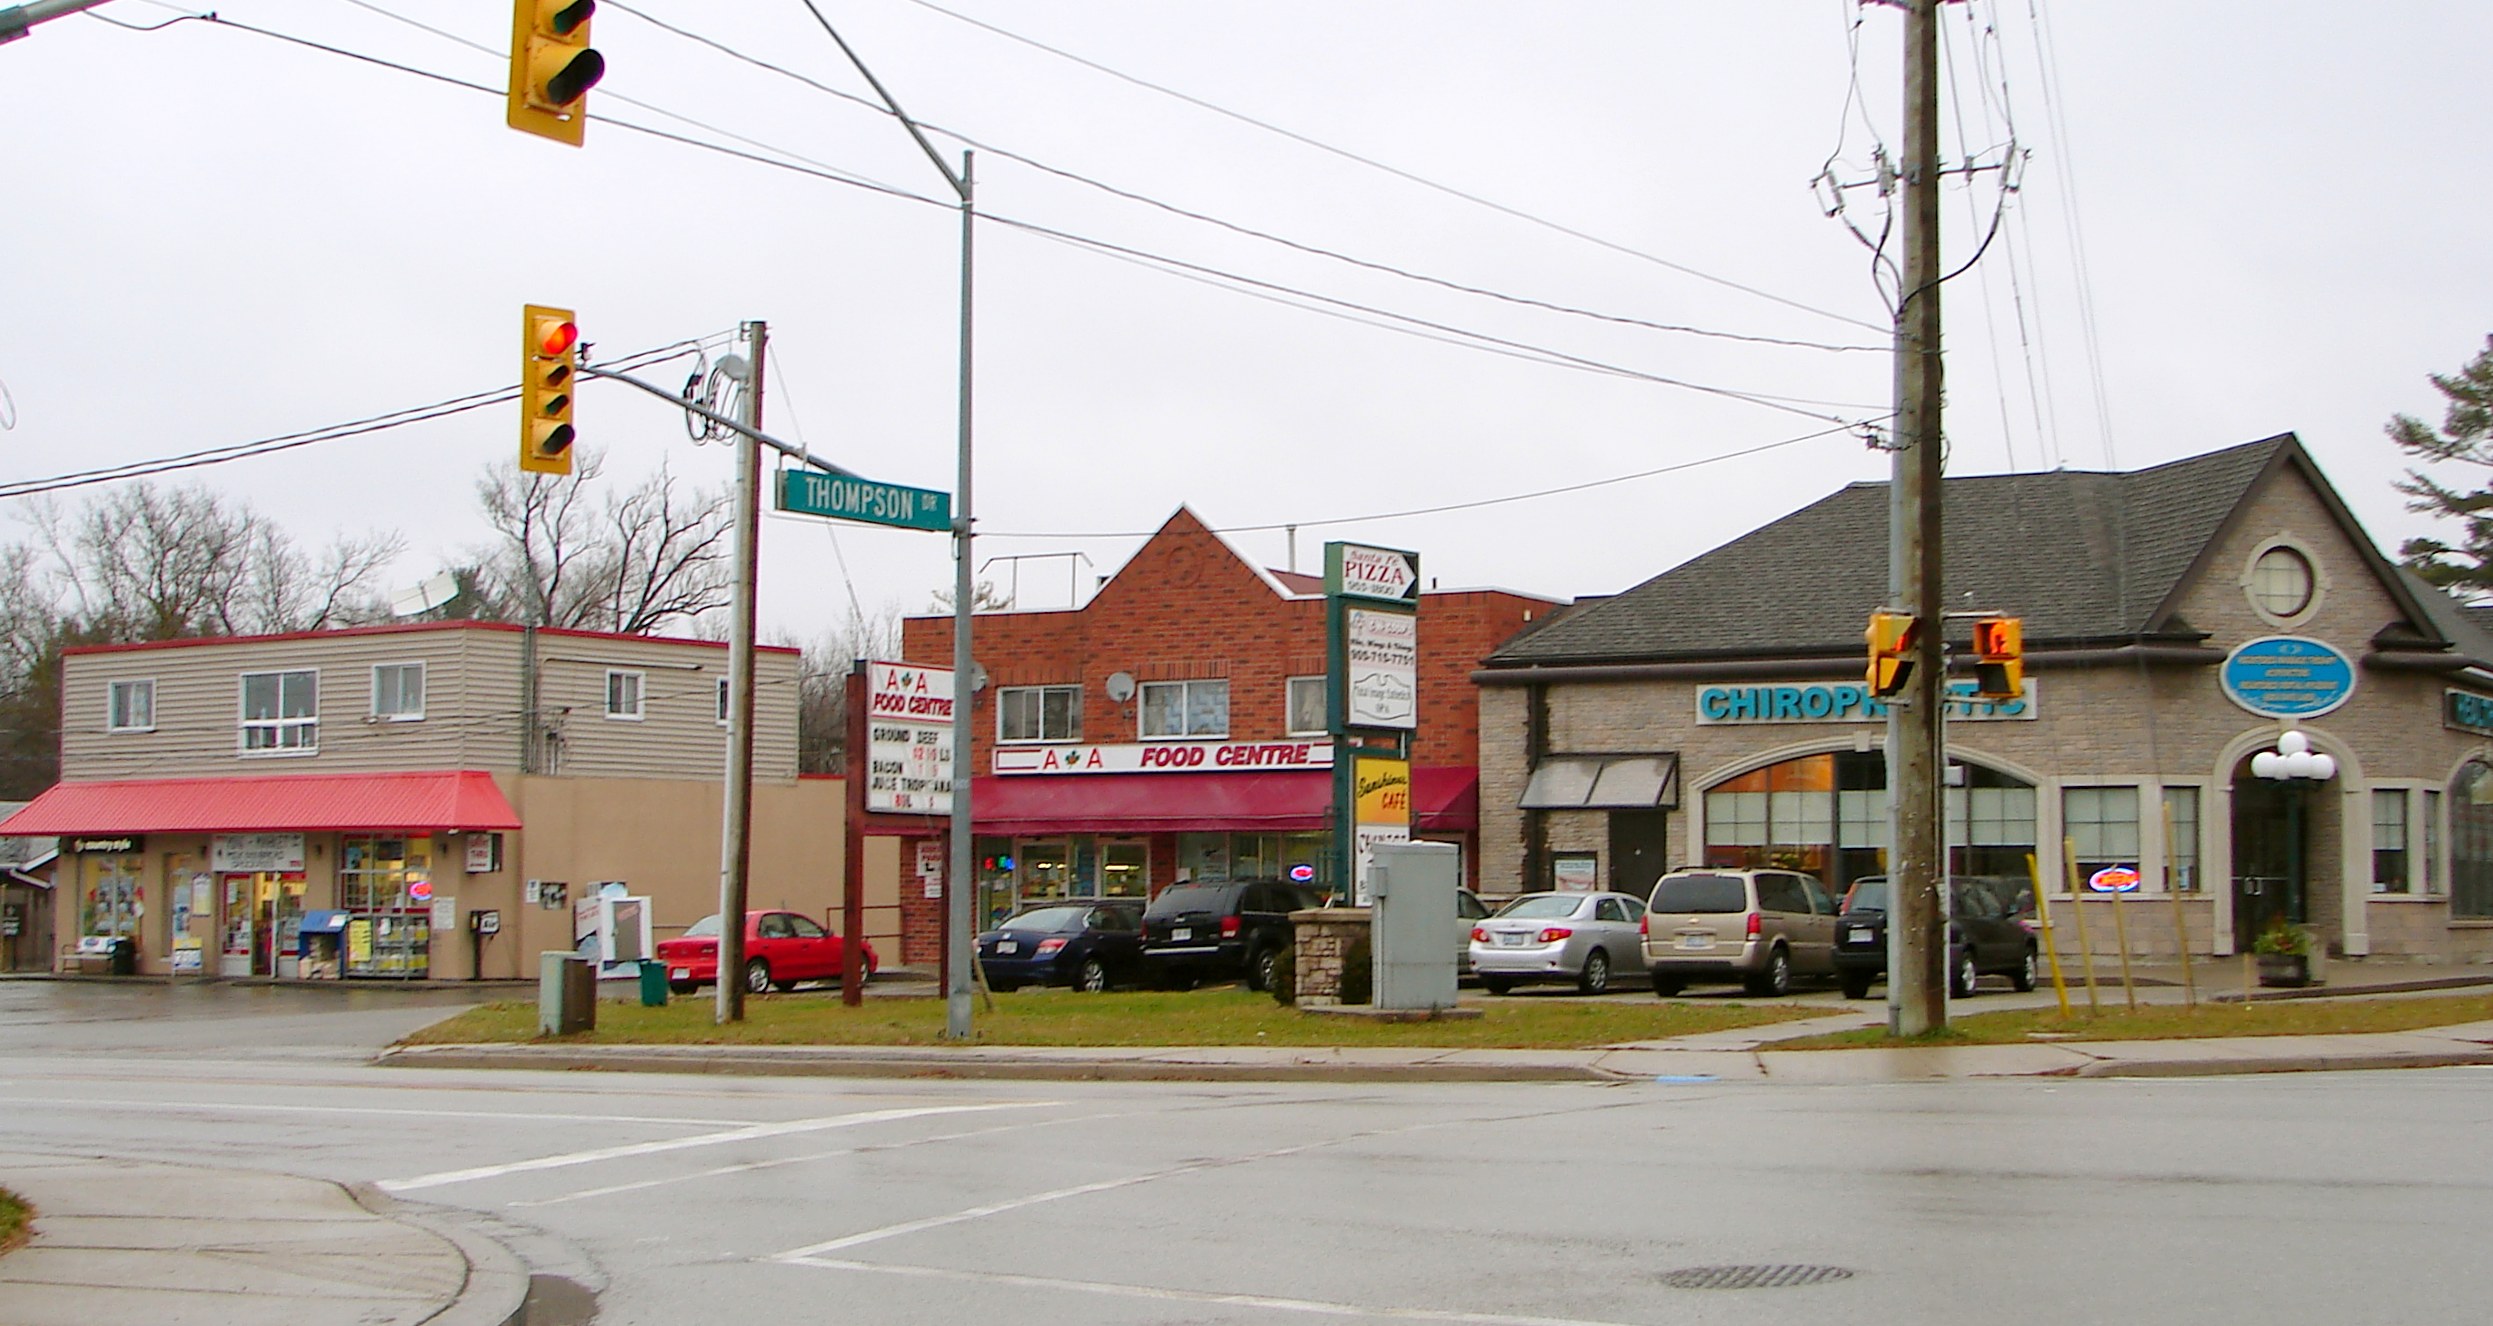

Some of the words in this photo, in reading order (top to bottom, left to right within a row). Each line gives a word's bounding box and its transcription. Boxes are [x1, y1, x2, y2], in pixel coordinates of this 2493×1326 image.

[805, 476, 914, 521] THOMPSON
[921, 493, 938, 512] DR
[1345, 560, 1405, 586] PIZZA
[886, 668, 899, 691] A
[915, 671, 928, 694] A
[874, 692, 906, 713] FOOD
[909, 696, 953, 717] CENTRE
[874, 728, 910, 742] GROUND
[917, 730, 938, 745] BEEF
[873, 760, 903, 775] BACON
[1043, 749, 1060, 770] A
[1086, 748, 1103, 769] A
[1140, 746, 1205, 768] FOOD
[1215, 743, 1312, 766] CENTRE
